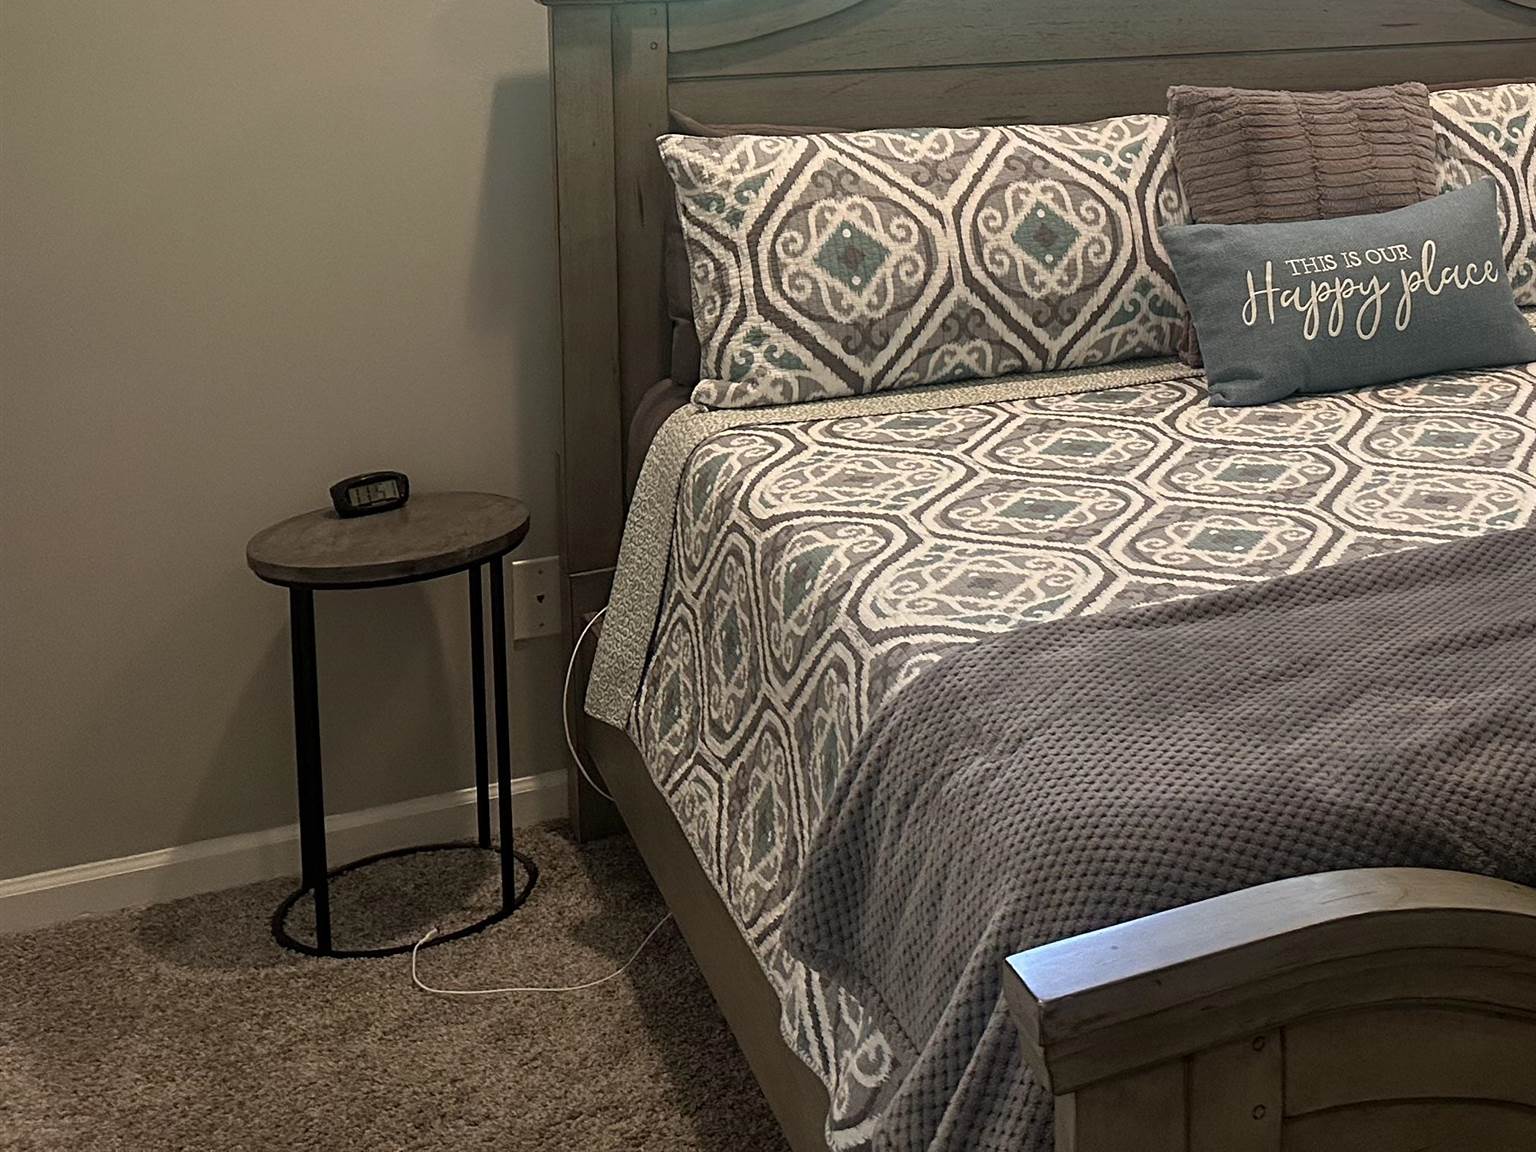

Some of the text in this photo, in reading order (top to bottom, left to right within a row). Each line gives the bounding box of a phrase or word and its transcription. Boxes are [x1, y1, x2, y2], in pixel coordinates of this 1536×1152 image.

[1241, 239, 1499, 341] Happy place
[1285, 243, 1412, 277] THIS IS OUR
